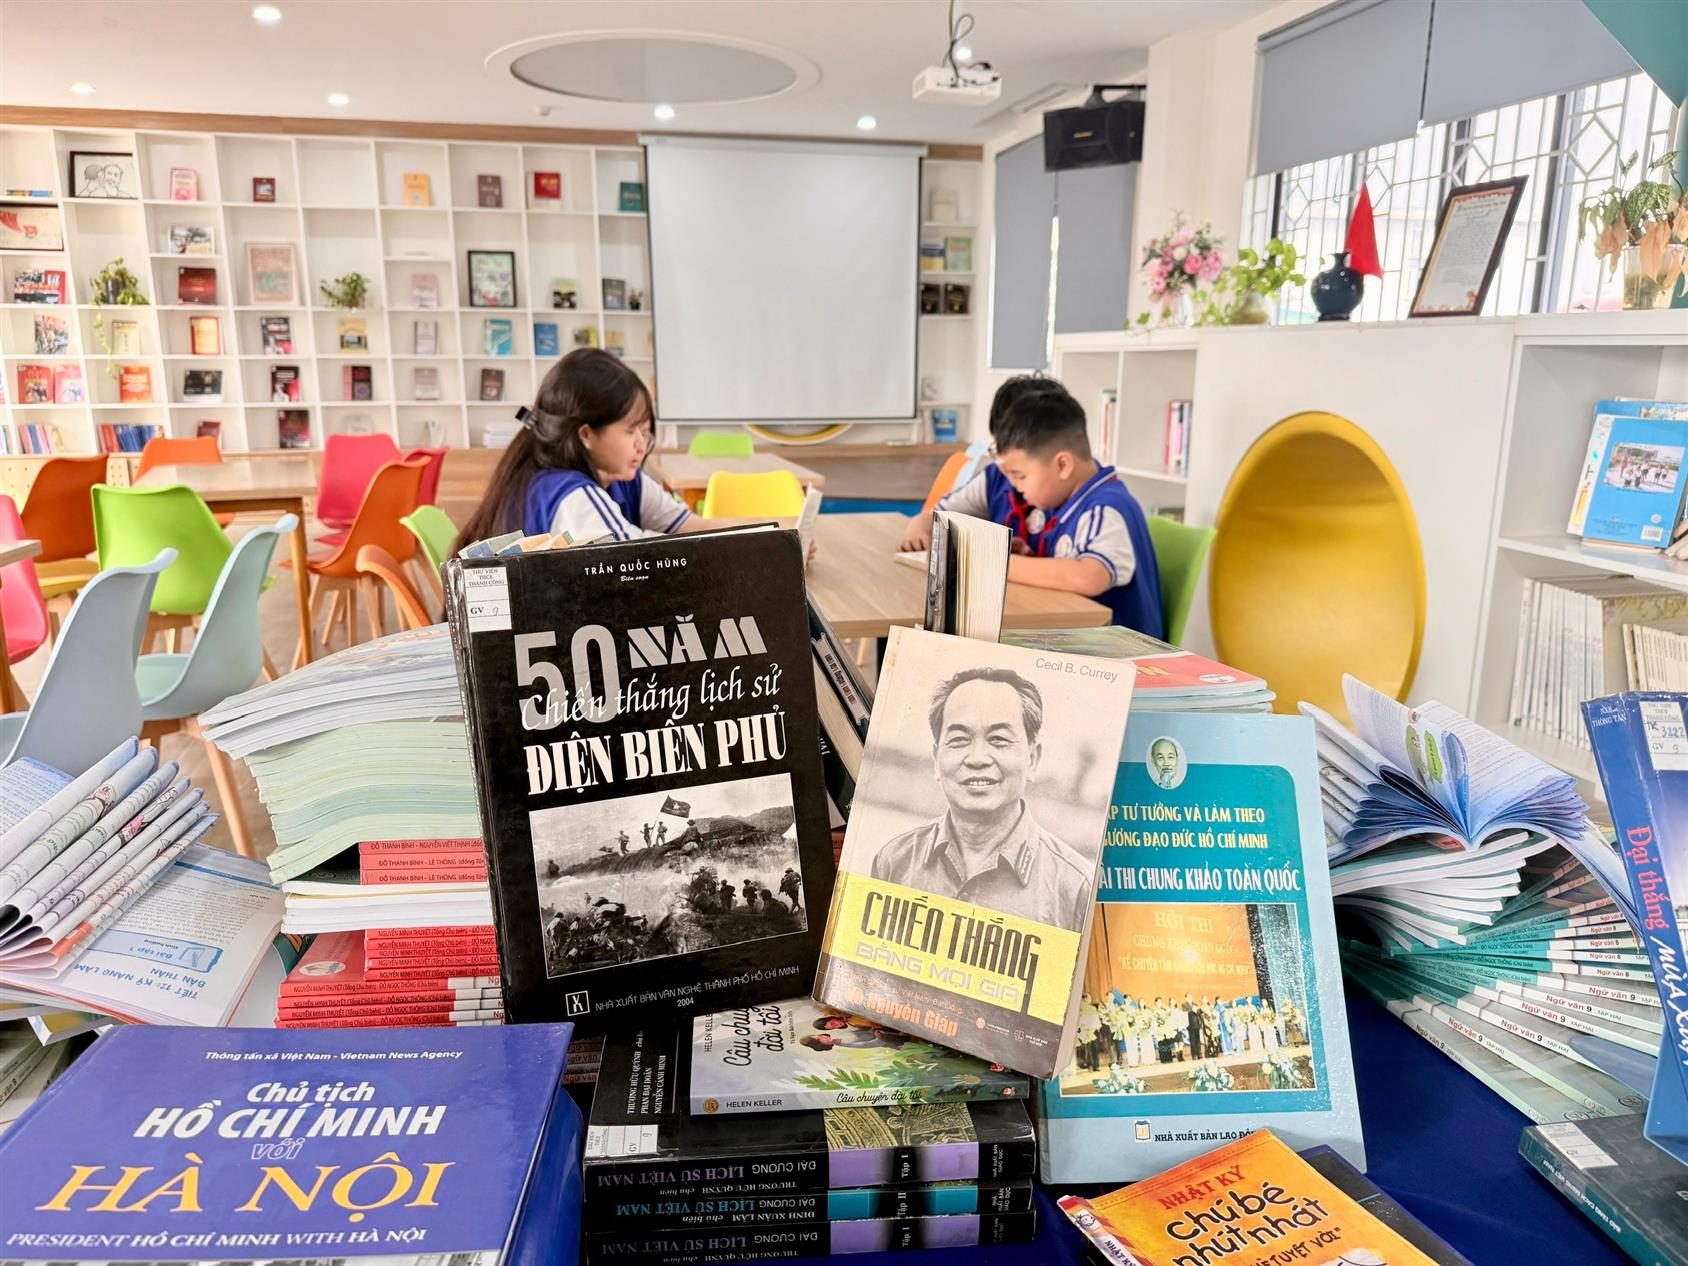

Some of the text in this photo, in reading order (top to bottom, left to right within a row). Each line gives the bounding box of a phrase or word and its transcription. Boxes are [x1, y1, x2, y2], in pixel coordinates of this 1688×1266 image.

[584, 564, 613, 576] TRẦN
[619, 559, 650, 573] QUỐC
[470, 606, 484, 615] GV
[514, 612, 768, 731] 50 NĂM
[1035, 658, 1118, 683] Cecil B. Currey
[522, 680, 606, 732] Chiến
[615, 673, 690, 719] thắng
[702, 665, 745, 711] lịch
[752, 663, 783, 697] sử
[523, 704, 787, 796] ĐIỆN BIÊN PHỦ
[1122, 802, 1265, 823] TƯ TƯỞNG VÀ LÀM THEO
[1143, 832, 1169, 851] ĐẠO
[1171, 827, 1196, 848] ĐỨC
[1199, 826, 1214, 848] HỒ
[1217, 829, 1236, 848] CHÍ
[1238, 833, 1268, 849] MINH
[1626, 826, 1658, 865] Đại
[1115, 859, 1301, 895] THI CHUNG KHẢO TOÀN QUỐC
[1637, 871, 1671, 932] thắng
[1154, 910, 1215, 933] HỘI THI
[860, 891, 1042, 1016] CHIẾN THẮNG
[150, 967, 178, 980] THÂN
[855, 941, 923, 974] BẰNG
[928, 962, 972, 992] MỌI
[978, 976, 1020, 1005] GIÁ
[175, 987, 198, 999] TIẾT
[595, 1001, 614, 1011] NHÀ
[615, 993, 637, 1008] XUẤT
[639, 990, 657, 1004] BẢN
[704, 977, 732, 991] THÀNH
[733, 972, 750, 985] PHỐ
[750, 970, 763, 982] HỒ
[764, 967, 777, 979] CHÍ
[778, 965, 800, 977] MINH
[677, 997, 694, 1007] 2004
[1521, 1001, 1566, 1023] Ngữ văn 9
[1546, 994, 1592, 1013] Ngữ văn 9
[704, 1014, 714, 1052] HELEN KELLE
[753, 1005, 784, 1052] đời tôi
[924, 1009, 960, 1038] Giáp
[1500, 1018, 1543, 1043] Ngữ văn 9
[205, 1050, 463, 1061] Thông tấn xã Việt Nam Vietnam News Agency
[723, 1038, 752, 1066] Câu
[246, 1081, 376, 1108] Chủ tịch
[652, 1055, 667, 1114] NGUYỄN CẢNH MINH
[640, 1097, 650, 1114] PHAN
[726, 1099, 782, 1109] HELEN KELLER
[836, 1090, 923, 1105] Câu chuyện đời tôi
[132, 1098, 447, 1139] HỒ CHÍ MINH
[1154, 1132, 1173, 1142] NHÀ
[1175, 1130, 1198, 1142] XUẤT
[1200, 1129, 1218, 1141] BẢN
[1220, 1131, 1238, 1140] LAO
[251, 1137, 306, 1160] với
[598, 1161, 816, 1187] ĐẠI CƯƠNG LỊCH SỬ VIỆT NAM
[35, 1151, 456, 1223] HÀ NỘI
[1157, 1181, 1216, 1210] NHẬT
[616, 1198, 815, 1216] ĐẠI CƯƠNG LỊCH SỬ VIỆT NAM
[682, 1214, 703, 1223] biên
[732, 1213, 755, 1222] LÂM
[760, 1212, 786, 1220] XUÂN
[788, 1211, 815, 1219] ĐINH
[1166, 1181, 1296, 1241] chú bé
[5, 1227, 427, 1248] PRESIDENT HỒ CHÍ MINH WITH HÀ NỘI
[1172, 1197, 1330, 1266] nhút nhát
[1269, 1240, 1313, 1266] TUYỆT
